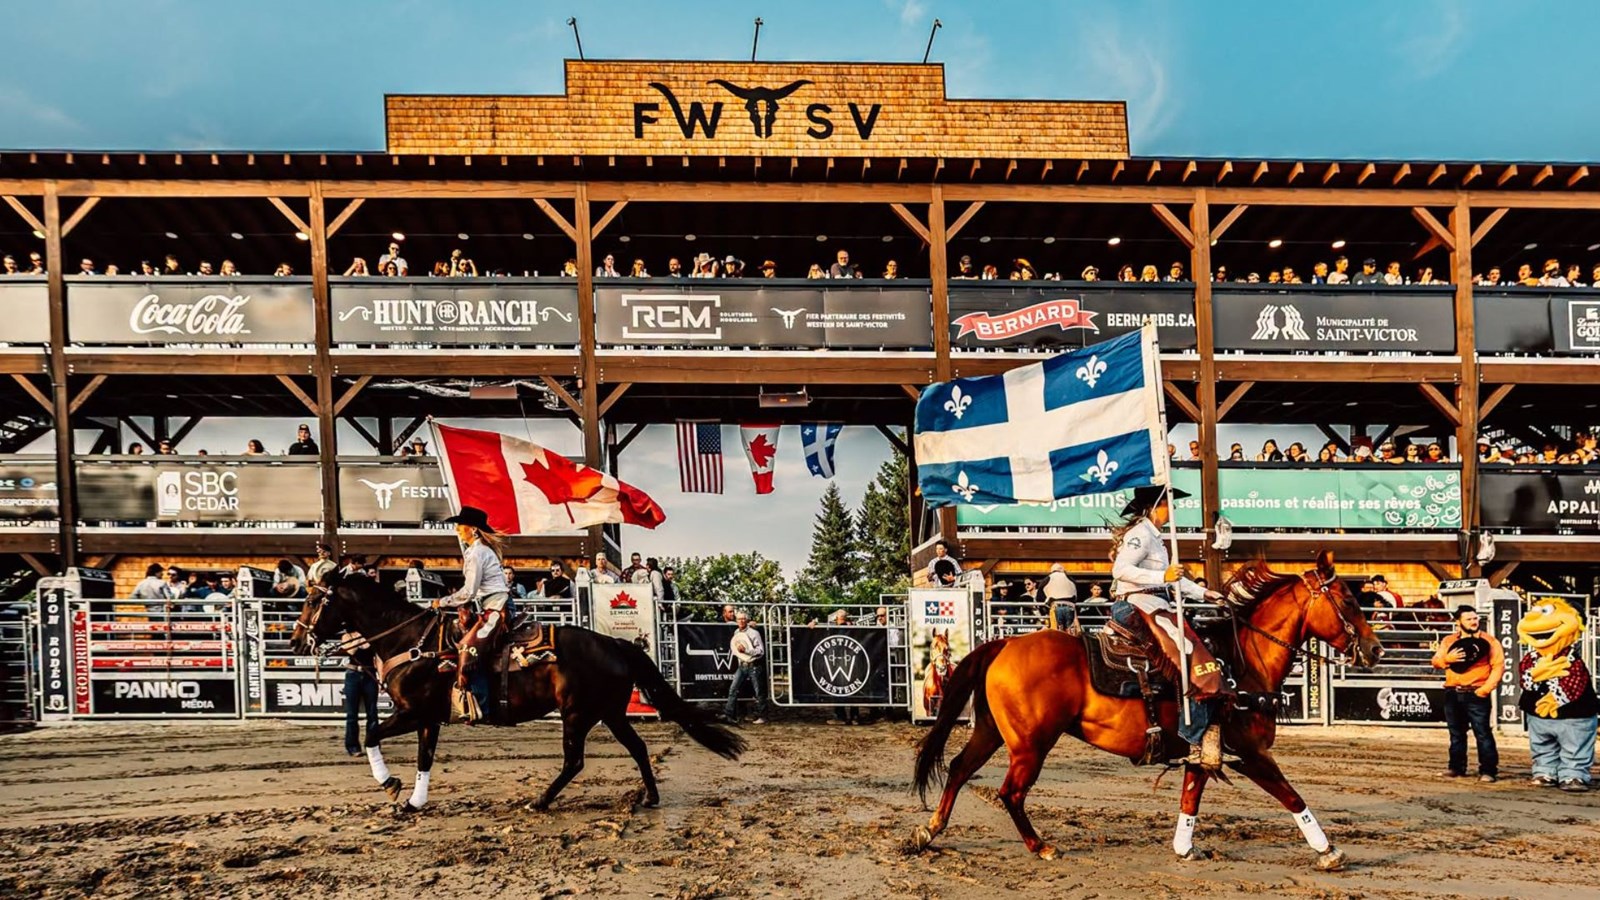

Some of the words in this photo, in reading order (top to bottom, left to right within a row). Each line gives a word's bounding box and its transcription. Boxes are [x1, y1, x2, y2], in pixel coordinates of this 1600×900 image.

[374, 300, 436, 325] HUNT
[459, 300, 539, 326] RANCH
[632, 305, 711, 329] RCM
[872, 312, 906, 320] FESTIVITÉS
[978, 304, 1075, 335] BERNARD
[1316, 328, 1419, 342] SAINT-VICTOR
[185, 471, 239, 496] SBC
[185, 497, 239, 511] CEDAR
[1178, 499, 1200, 509] ses
[1221, 497, 1281, 510] passions
[1284, 498, 1299, 509] et
[1303, 496, 1355, 509] réaliser
[1358, 500, 1385, 509] ses
[1384, 496, 1421, 510] rêves
[816, 637, 861, 655] HOSTILE
[75, 629, 89, 695] GOLDRIDE
[248, 661, 260, 698] CANTINE
[695, 673, 722, 681] HOSTILE
[818, 676, 863, 694] WESTERN
[115, 681, 200, 698] PANNO
[1309, 685, 1319, 708] RMG
[181, 699, 214, 709] MÉDIA
